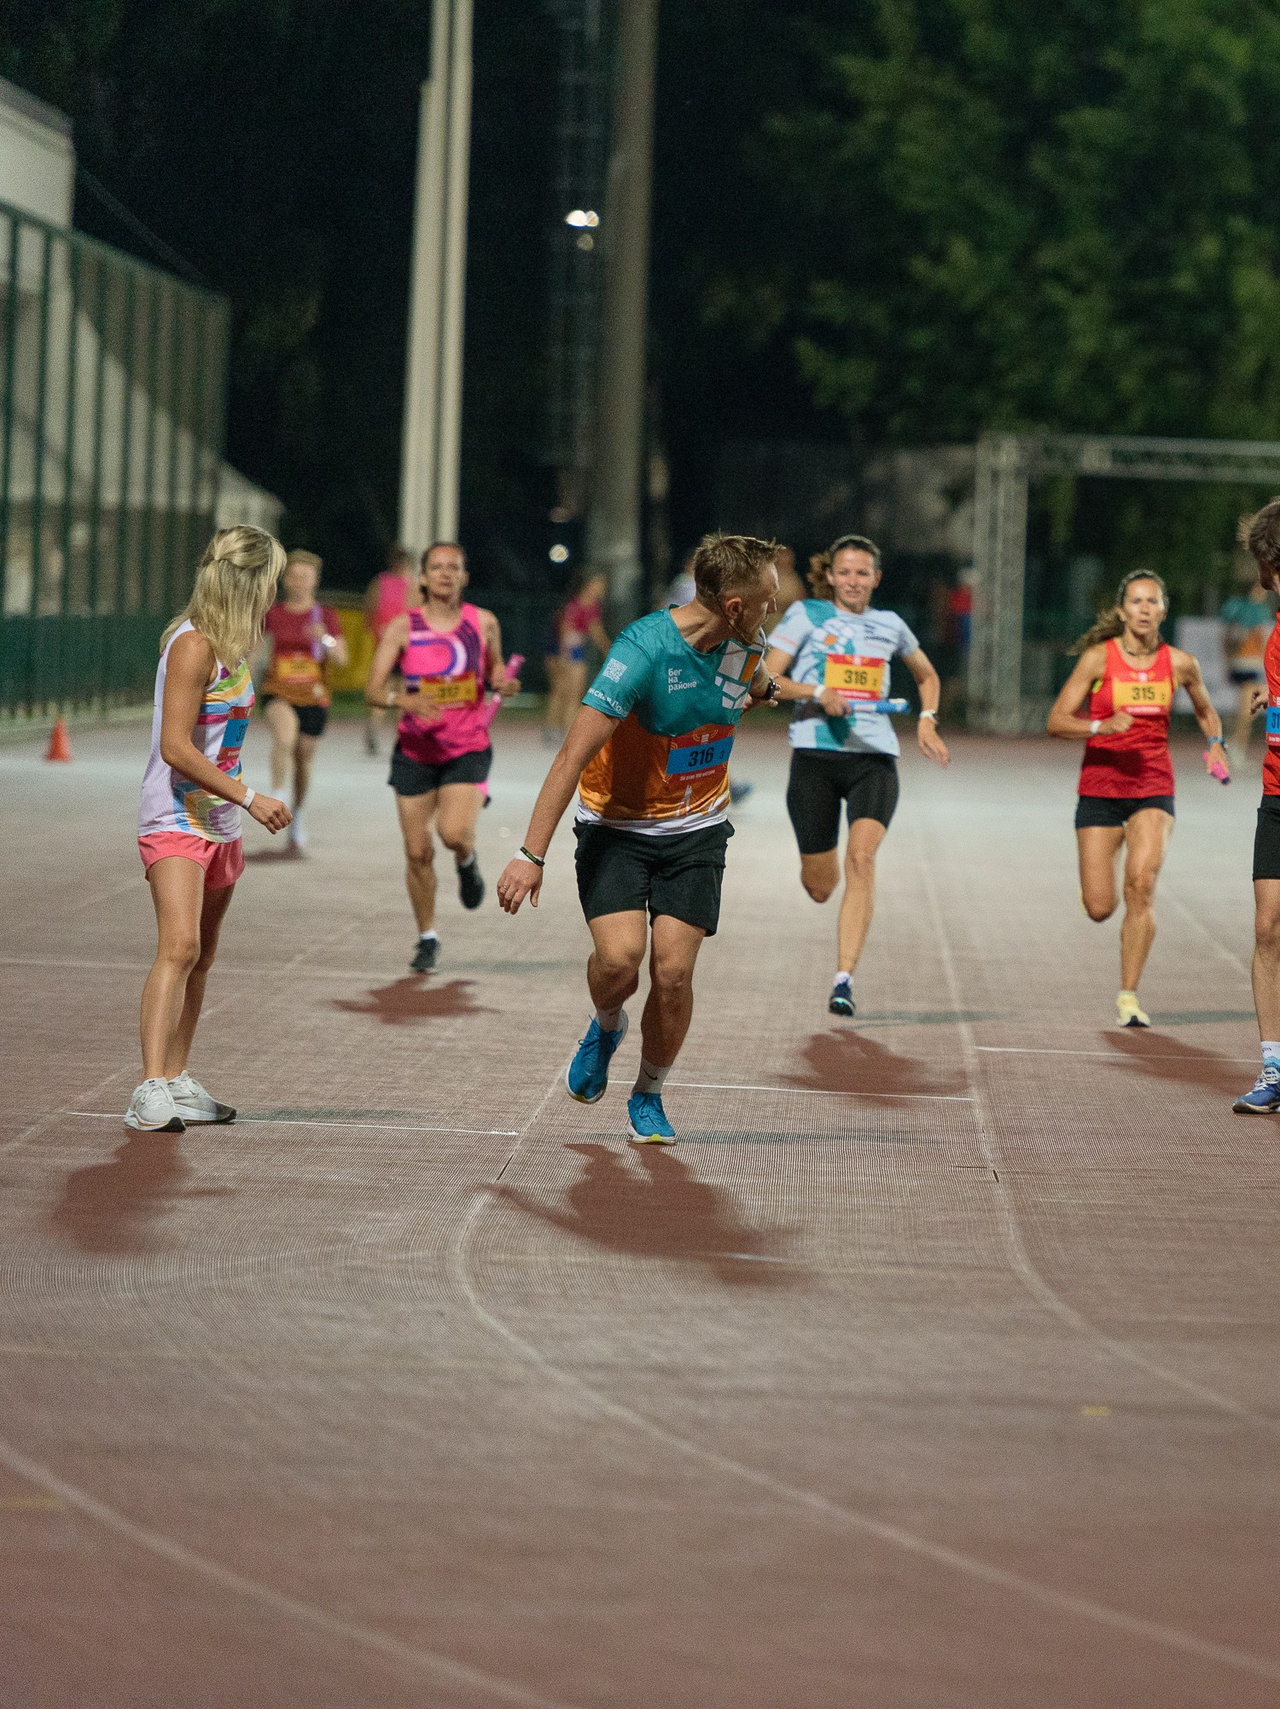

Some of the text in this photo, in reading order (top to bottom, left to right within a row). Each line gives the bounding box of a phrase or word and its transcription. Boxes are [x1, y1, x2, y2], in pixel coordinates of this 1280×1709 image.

[668, 668, 682, 677] бег
[843, 669, 868, 685] 316
[668, 676, 679, 684] на
[668, 680, 697, 694] районе
[1132, 686, 1156, 700] 315
[687, 747, 725, 768] 316 3
